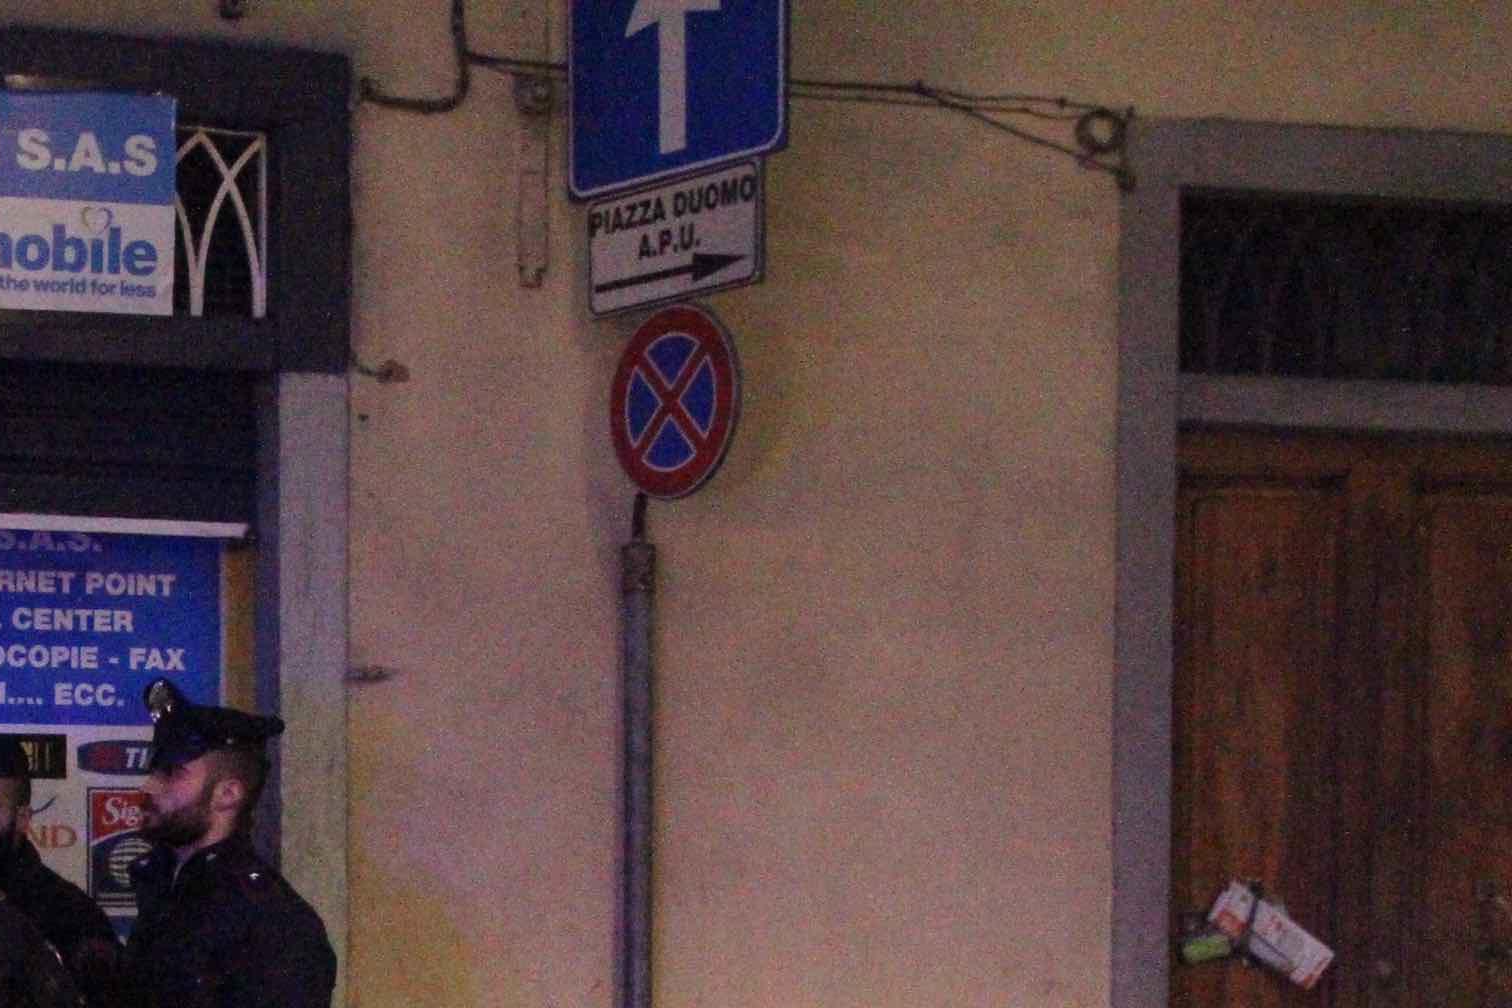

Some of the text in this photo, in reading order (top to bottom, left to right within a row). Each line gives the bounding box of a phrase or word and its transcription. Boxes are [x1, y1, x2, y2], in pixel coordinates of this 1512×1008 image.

[15, 128, 158, 176] S.A.S
[589, 174, 757, 237] PIAZZA DUOMO
[638, 222, 701, 260] A.P.U.
[33, 277, 86, 294] world
[90, 279, 117, 295] for
[120, 280, 157, 298] less
[85, 573, 176, 598] POINT
[12, 608, 134, 633] CENTER
[128, 648, 186, 671] FAX
[54, 683, 125, 707] ECC.
